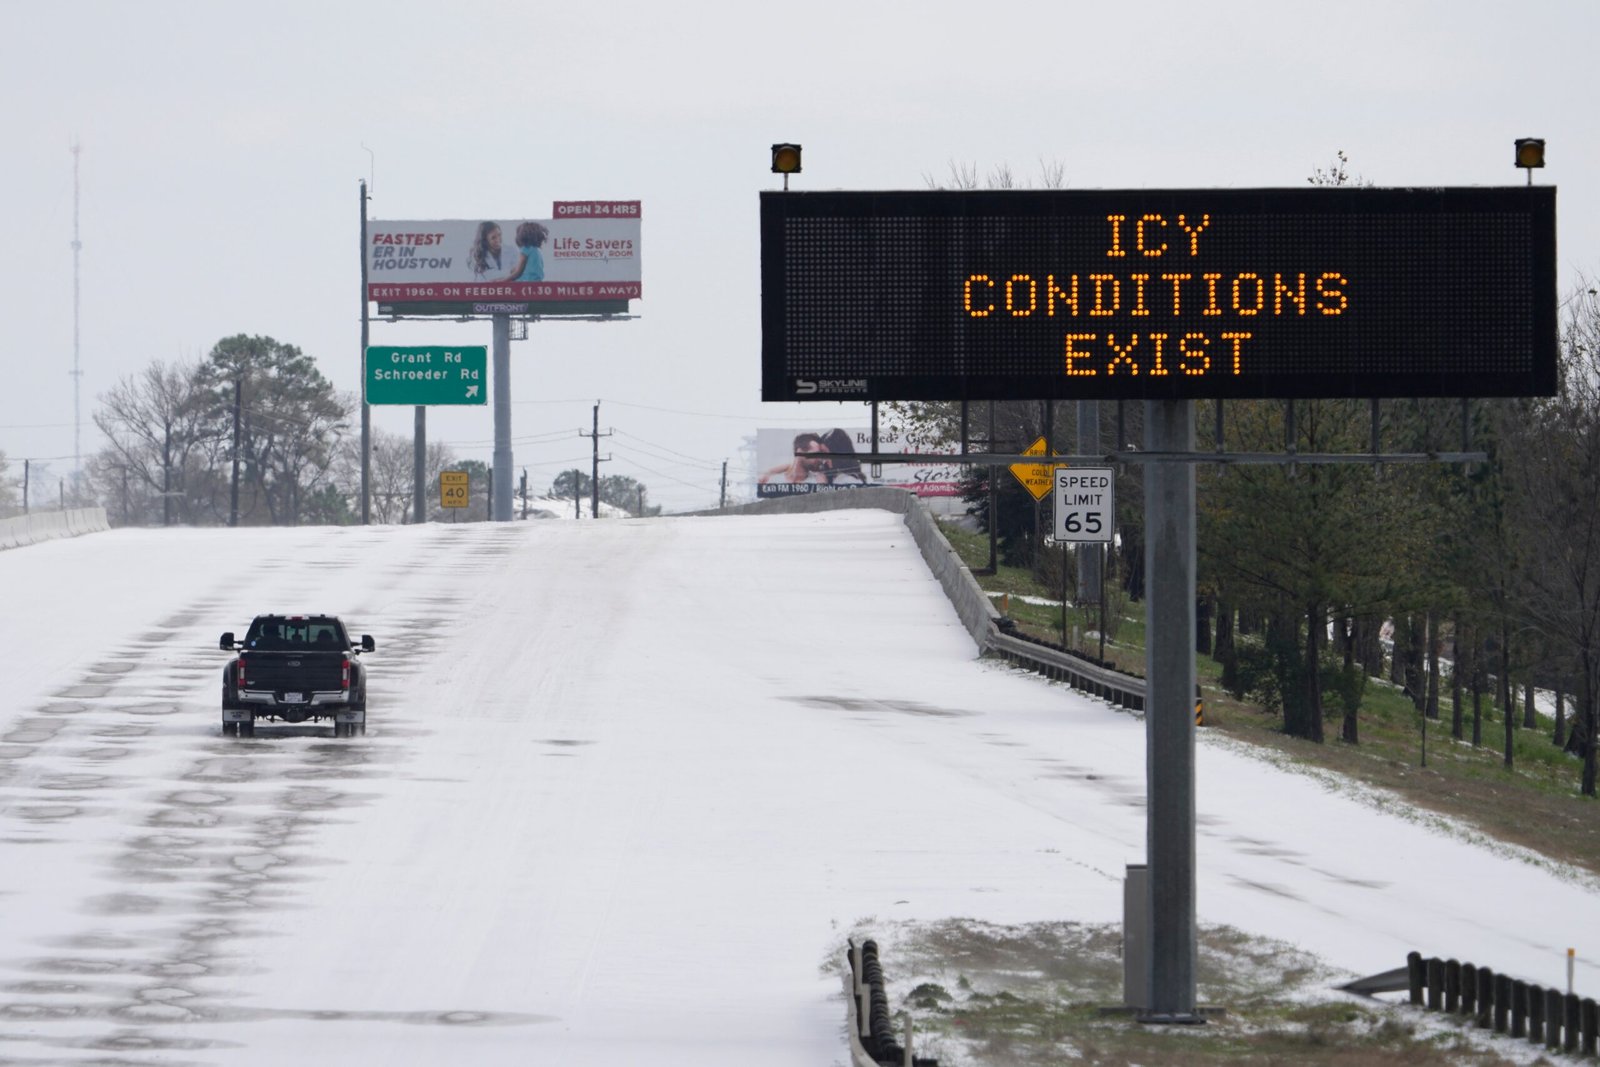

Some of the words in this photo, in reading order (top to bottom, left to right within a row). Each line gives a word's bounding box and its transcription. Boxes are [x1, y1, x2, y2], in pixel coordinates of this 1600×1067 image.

[557, 205, 592, 214] OPEN
[594, 204, 610, 214] 24
[612, 204, 637, 214] HRS
[372, 233, 445, 246] FASTEST
[1106, 214, 1211, 257] ICY
[553, 237, 580, 250] Life
[585, 237, 633, 250] Savers
[372, 246, 397, 258] ER
[398, 246, 416, 258] IN
[553, 250, 606, 258] EMERGENCY
[608, 250, 634, 258] ROOM
[372, 257, 452, 270] HOUSTON
[373, 288, 402, 297] EXIT
[443, 287, 460, 297] ON
[465, 287, 516, 297] FEEDER.
[521, 286, 552, 297] (1.30
[557, 286, 594, 296] MILES
[599, 285, 639, 296] AWAY)
[963, 272, 1349, 318] CONDITIONS
[474, 303, 526, 313] OUTFRONT
[391, 352, 432, 363] Grant
[444, 352, 462, 363] Rd
[1064, 332, 1253, 377] EXIST
[374, 368, 448, 380] Schroeder
[460, 368, 479, 380] Rd
[818, 379, 868, 387] SKYLINE
[856, 433, 899, 444] Boed?
[1059, 476, 1109, 488] SPEED
[446, 487, 465, 498] 40
[762, 485, 777, 493] Exit
[791, 484, 809, 493] 1960
[1064, 494, 1103, 506] LIMIT
[1064, 512, 1102, 533] 65
